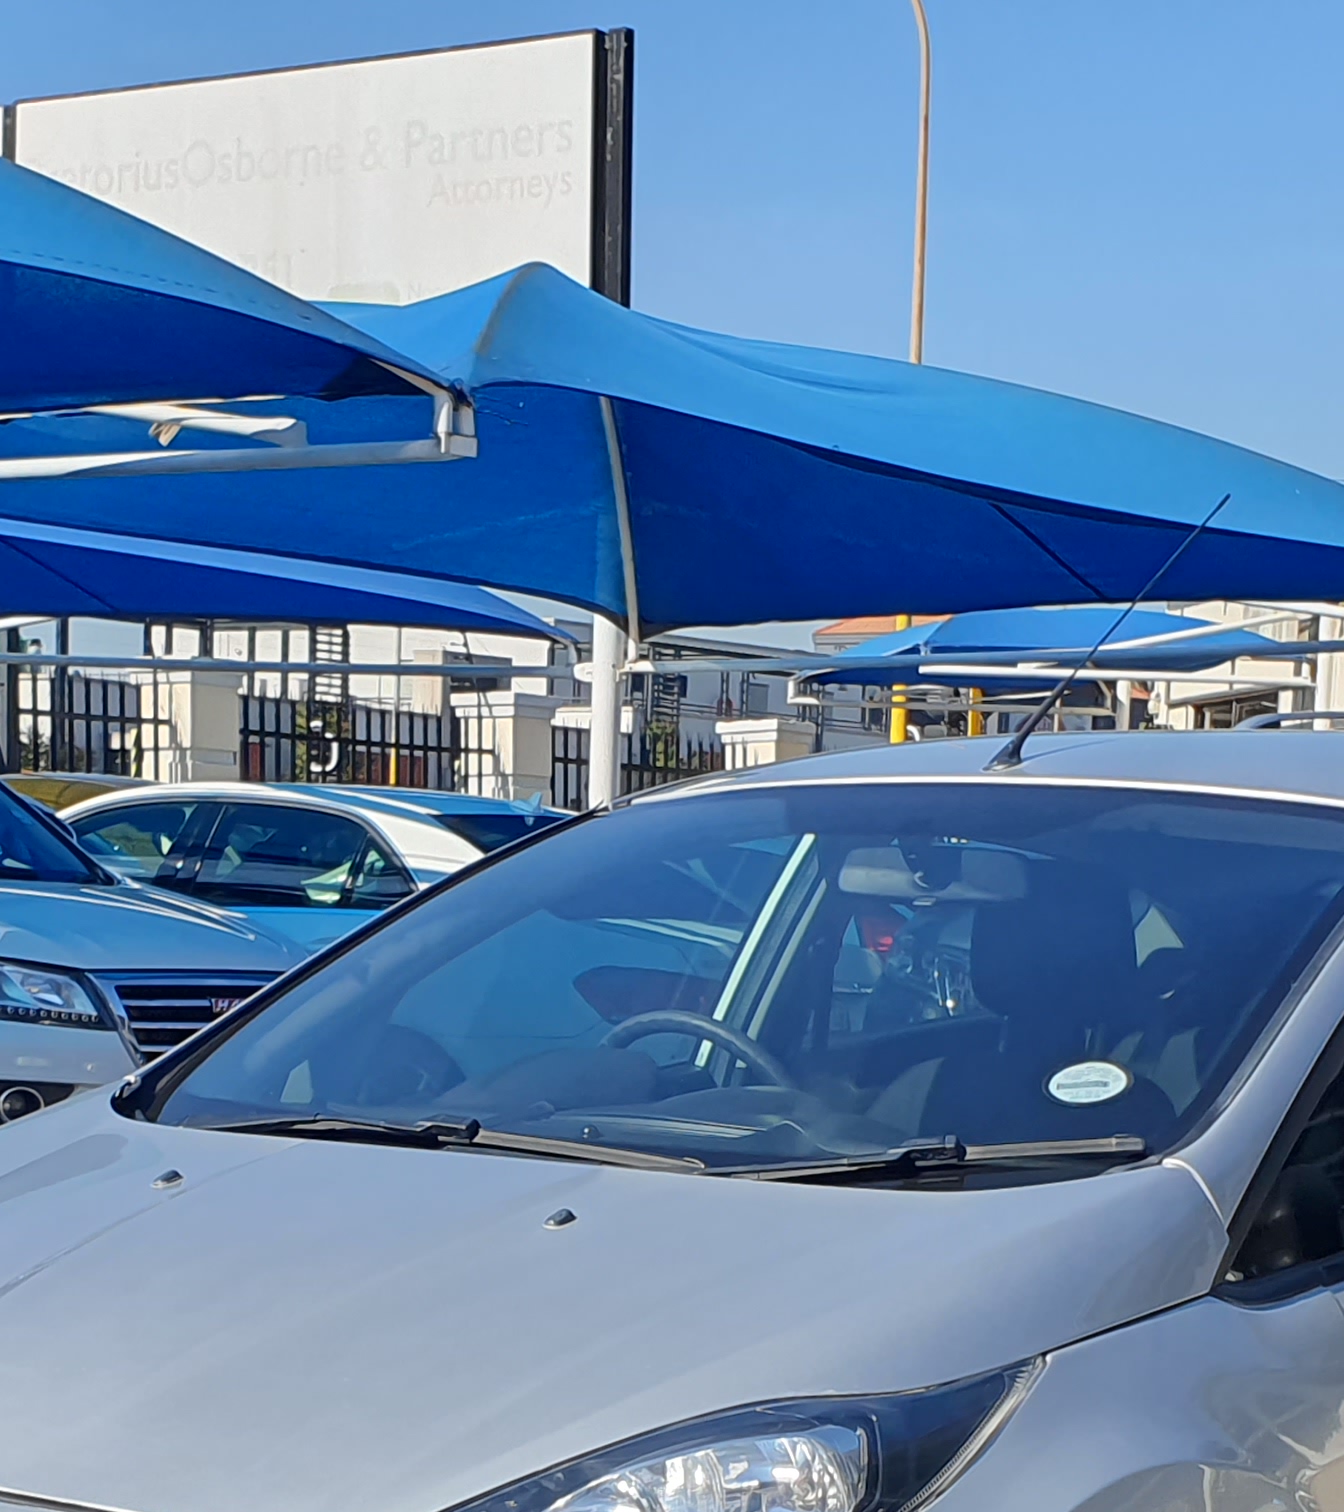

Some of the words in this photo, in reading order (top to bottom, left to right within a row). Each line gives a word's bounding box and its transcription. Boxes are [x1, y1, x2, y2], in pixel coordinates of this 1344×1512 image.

[359, 125, 391, 171] &
[403, 117, 574, 170] Partners
[425, 169, 574, 209] Attorneys
